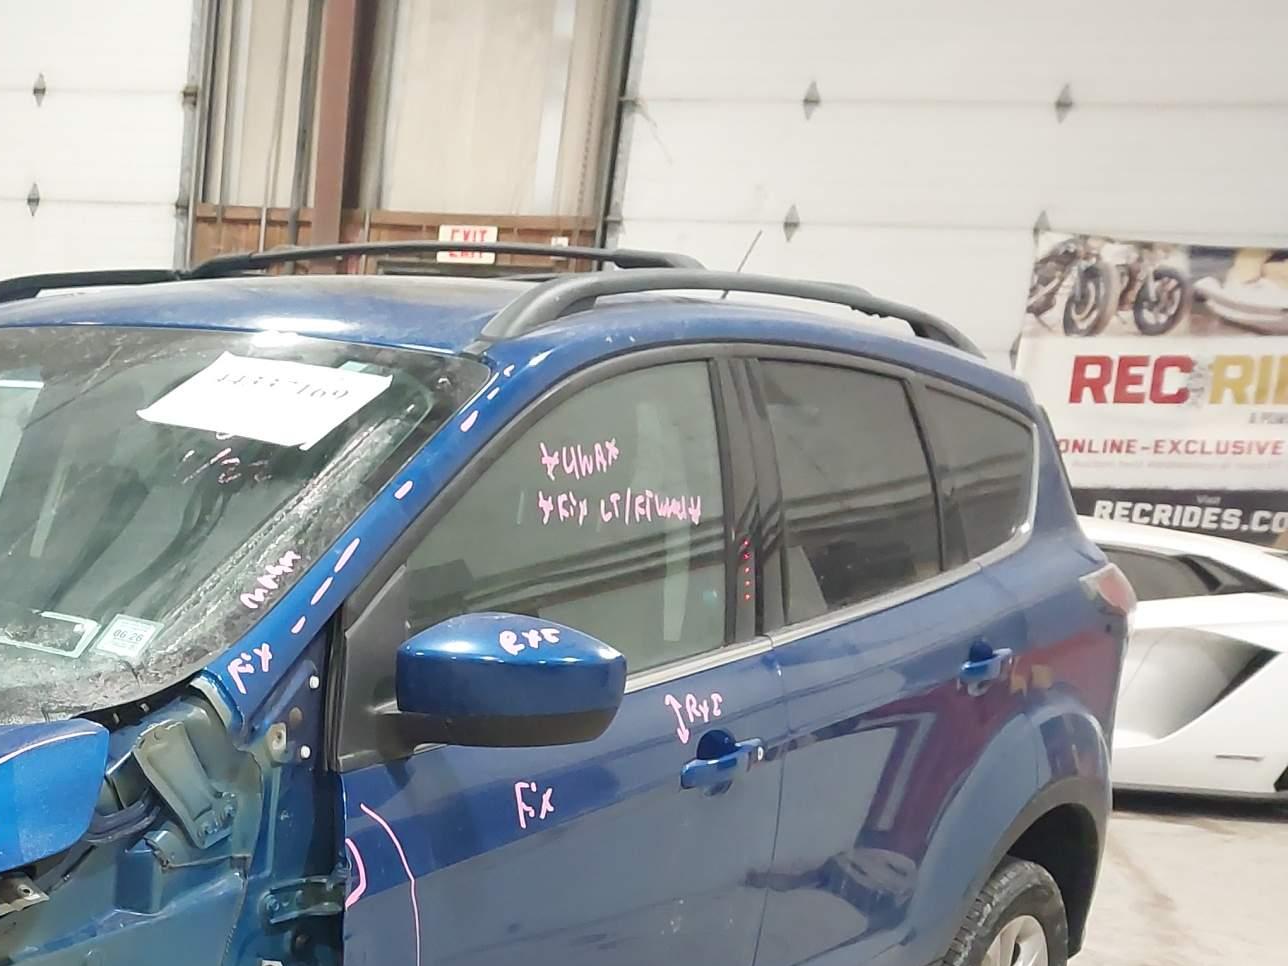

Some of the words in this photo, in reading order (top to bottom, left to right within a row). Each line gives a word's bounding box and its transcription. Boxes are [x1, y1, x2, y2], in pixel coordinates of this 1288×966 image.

[1068, 354, 1193, 404] REC
[1058, 438, 1284, 455] ONLINE-EXCLUSIVE
[1093, 499, 1288, 534] RECRIDES.CO
